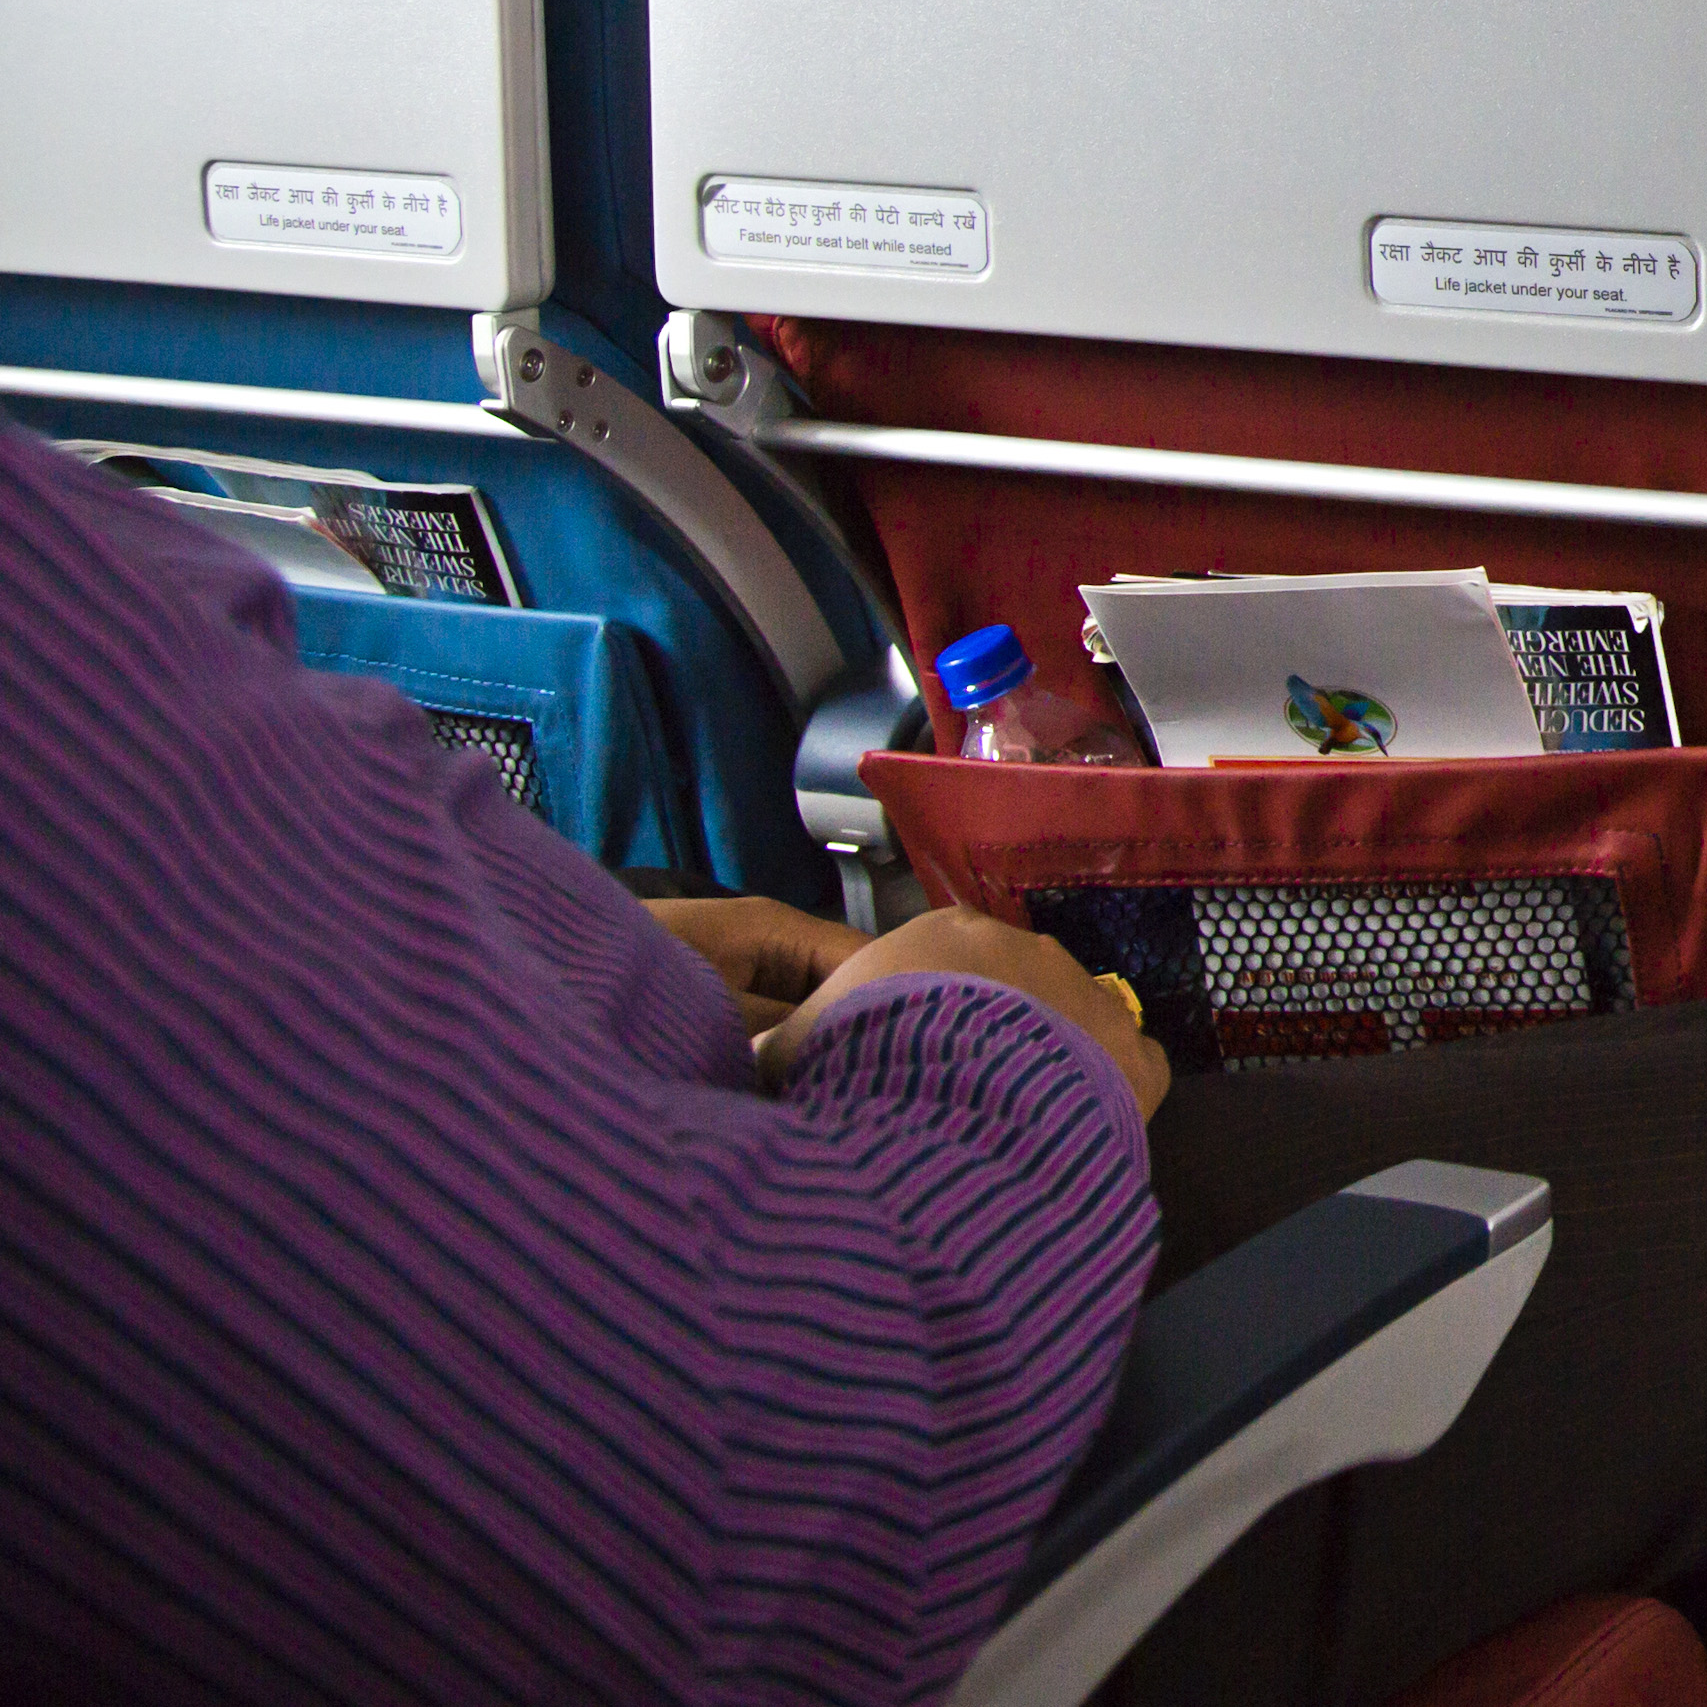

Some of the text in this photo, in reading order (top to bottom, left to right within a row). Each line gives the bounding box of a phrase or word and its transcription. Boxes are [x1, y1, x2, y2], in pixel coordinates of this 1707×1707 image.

[215, 183, 447, 217] रक्षा जैकट आप की कुर्सी के नीचे है
[260, 214, 407, 236] Life jacket under your seat.
[743, 201, 761, 216] पर
[765, 198, 785, 217] बैठे
[789, 204, 808, 226] हुए
[812, 202, 842, 226] कुर्सी
[849, 204, 867, 222] की
[875, 205, 900, 224] पेटी
[953, 211, 976, 230] रखें
[740, 229, 951, 256] Fasten your seat belt while seated
[1379, 241, 1680, 279] रक्षा जैकट आप की कुर्सी के नीचे है
[1436, 277, 1628, 301] Life jacket under your seat.
[367, 523, 416, 547] NEW
[418, 531, 469, 553] THE
[1507, 630, 1630, 652] EMERGE
[1577, 654, 1636, 676] THE
